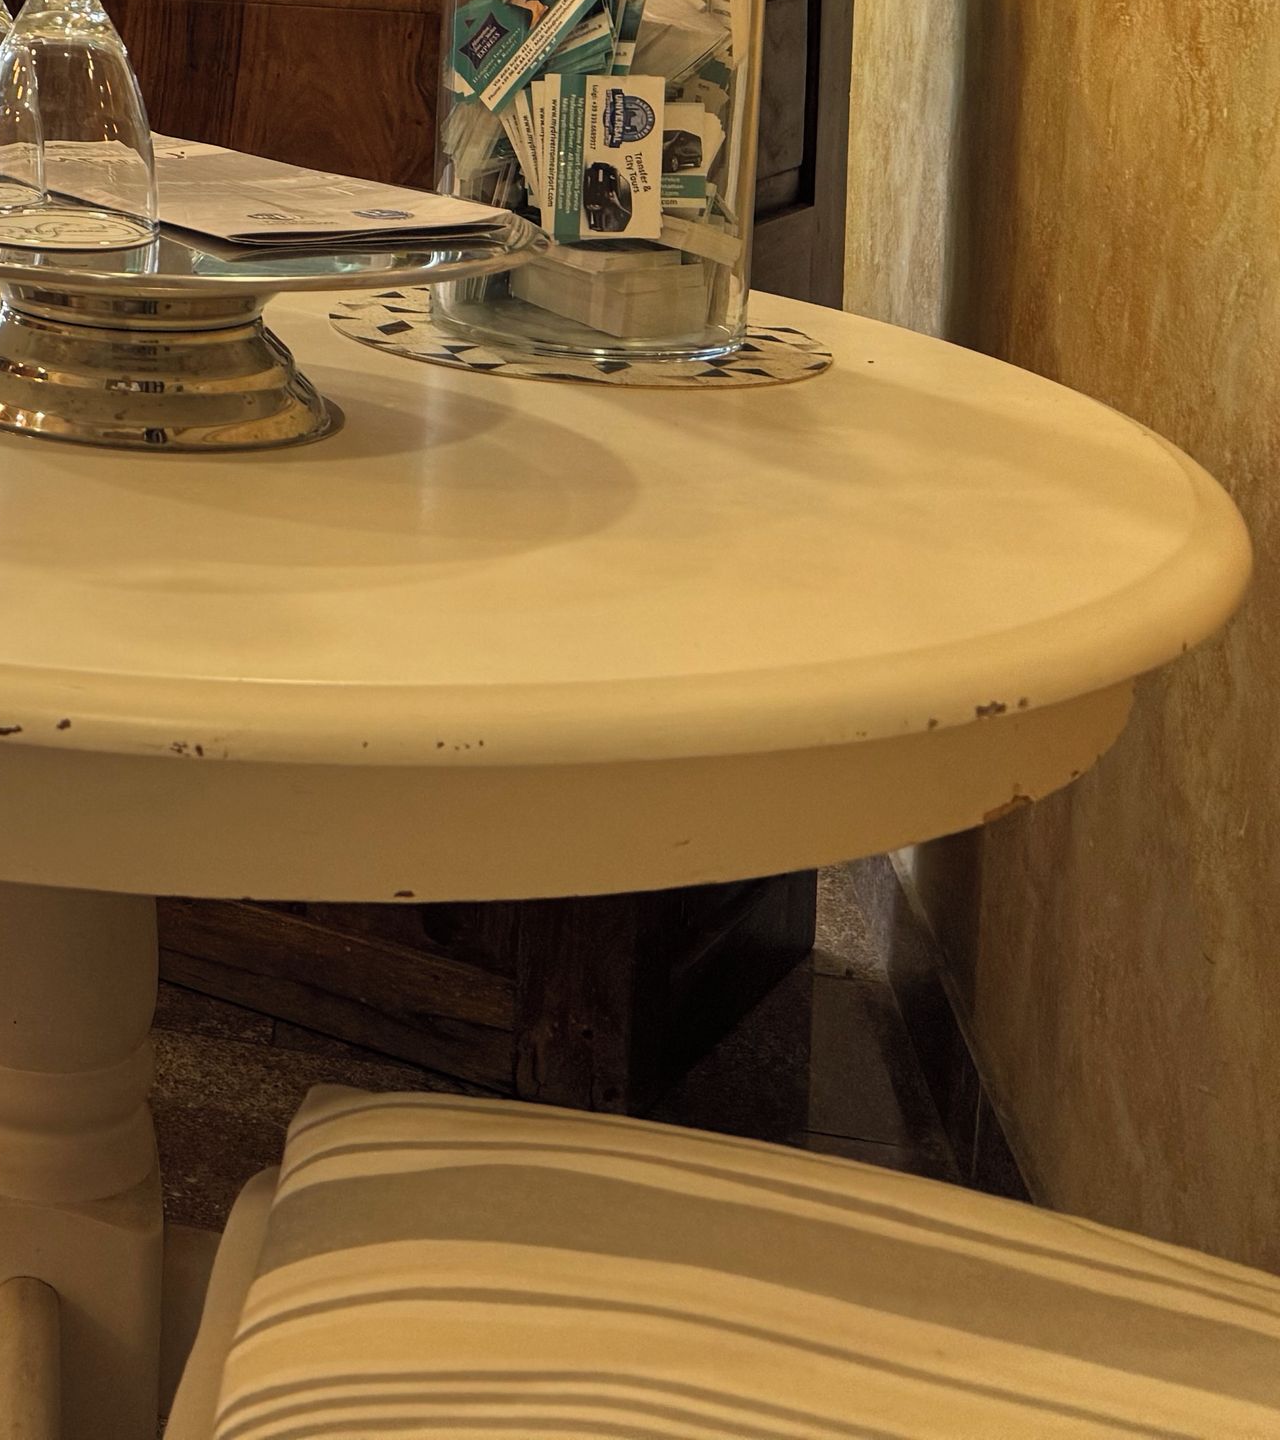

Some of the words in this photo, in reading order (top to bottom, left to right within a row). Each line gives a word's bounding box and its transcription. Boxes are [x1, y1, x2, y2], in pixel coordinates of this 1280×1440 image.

[475, 30, 501, 59] EXPRESS
[613, 94, 624, 143] UNIVERSAL
[624, 155, 635, 171] City
[634, 152, 648, 184] Transfer
[643, 185, 652, 193] &
[629, 172, 640, 193] Tours
